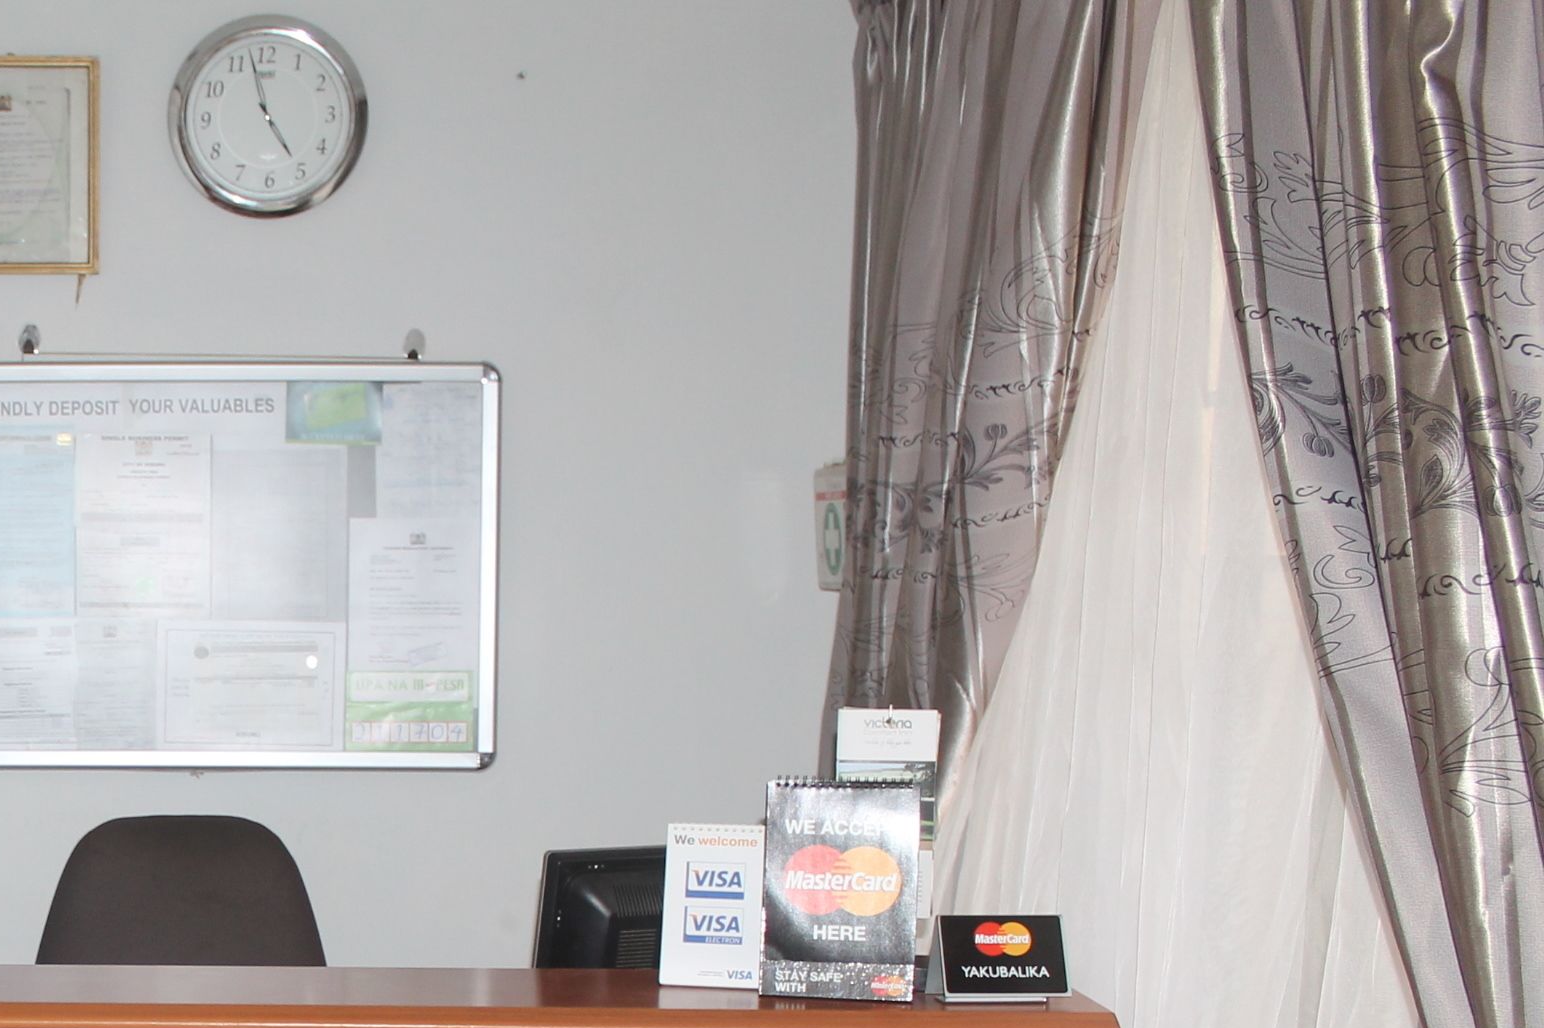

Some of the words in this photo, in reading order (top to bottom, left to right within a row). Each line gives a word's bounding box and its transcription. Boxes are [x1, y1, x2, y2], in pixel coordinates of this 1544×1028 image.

[257, 45, 277, 64] 12
[293, 53, 302, 71] 1
[228, 55, 244, 73] 11
[205, 80, 225, 98] 10
[316, 73, 327, 92] 2
[199, 111, 212, 130] 9
[324, 105, 336, 123] 3
[209, 142, 222, 160] 8
[316, 137, 328, 155] 4
[235, 164, 247, 182] 7
[264, 170, 276, 189] 6
[294, 162, 307, 181] 5
[48, 398, 120, 418] DEPOSIT
[128, 396, 176, 416] YOUR
[178, 396, 276, 416] VALUABLES
[388, 678, 408, 691] NA
[864, 715, 913, 730] victria
[785, 819, 816, 835] WE
[673, 834, 695, 847] We
[698, 835, 759, 848] welcome
[691, 868, 743, 889] VISA
[785, 870, 898, 892] MasterCard
[689, 913, 742, 934] VISA
[813, 924, 867, 941] HERE
[705, 936, 742, 946] ELECTRON
[974, 933, 1031, 945] MasterCard
[725, 969, 754, 981] VISA
[775, 970, 808, 983] STAY
[809, 970, 842, 983] SAFE
[960, 964, 1051, 979] YAKUBALIKA
[775, 982, 807, 993] WITH
